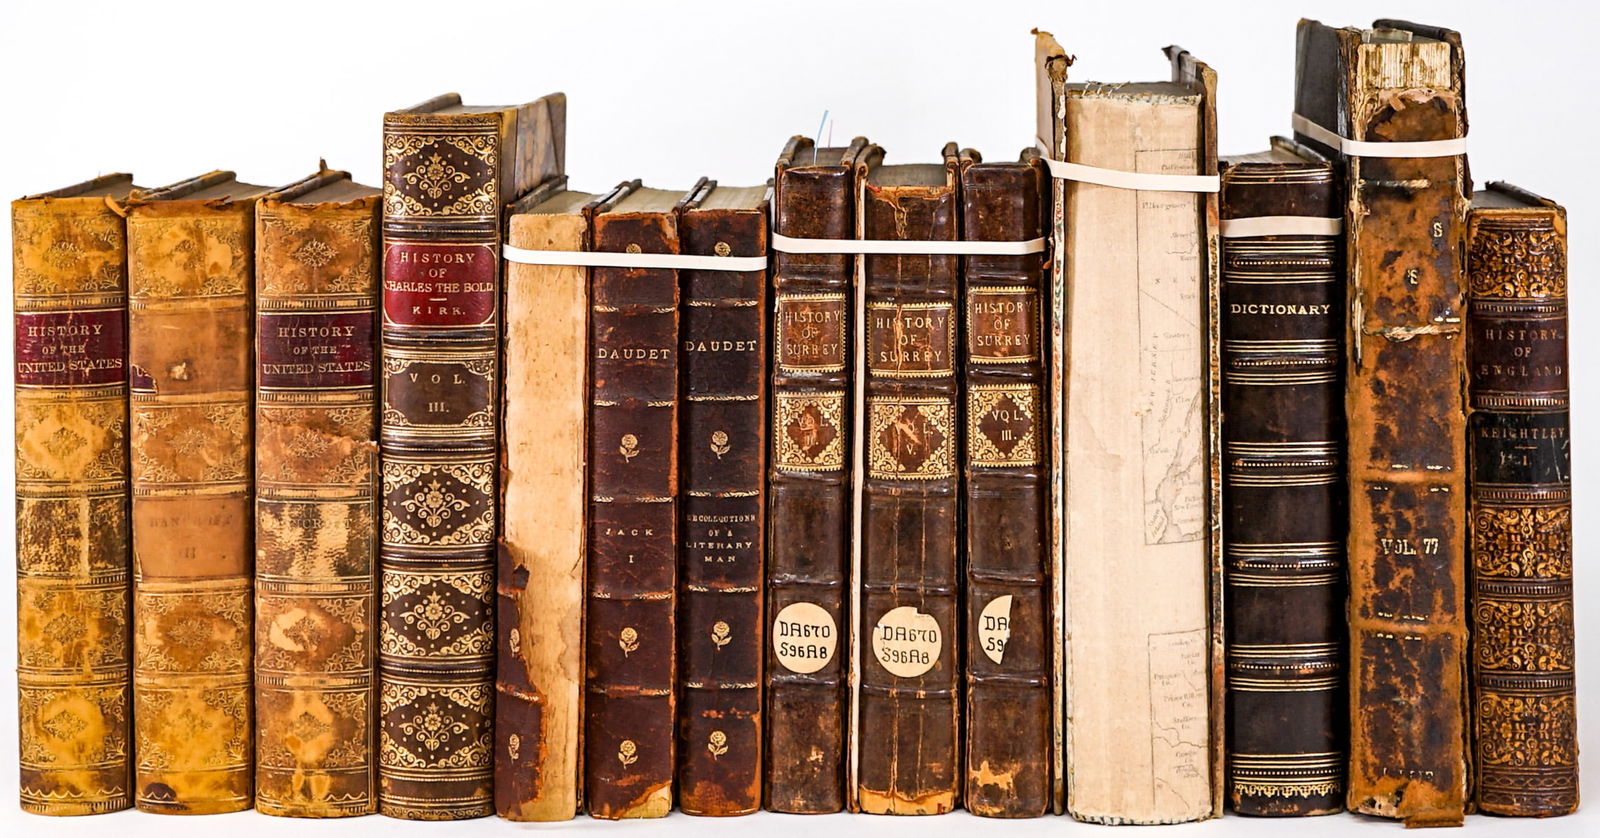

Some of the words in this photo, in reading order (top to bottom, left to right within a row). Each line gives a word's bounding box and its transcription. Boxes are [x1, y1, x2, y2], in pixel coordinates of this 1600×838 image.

[400, 252, 476, 264] HISTORY
[428, 268, 448, 278] OF
[384, 281, 432, 292] CHARLES
[435, 282, 460, 293] THE
[412, 306, 466, 315] KIRK.
[974, 302, 1032, 314] HISTORY
[1231, 304, 1330, 315] DICTIONARY
[785, 310, 840, 322] HISTORY
[994, 318, 1011, 330] OF
[28, 324, 102, 337] HISTORY
[278, 326, 355, 338] HISTORY
[802, 328, 818, 338] OF
[1486, 328, 1558, 340] HISTORY
[686, 340, 757, 352] DAUDET
[900, 334, 917, 346] OF
[977, 334, 1030, 346] SURREY
[42, 346, 56, 354] OF
[60, 345, 85, 354] THE
[294, 346, 308, 355] OF
[312, 346, 337, 354] THE
[598, 348, 670, 360] DAUDET
[787, 344, 838, 356] SURREY
[1514, 346, 1532, 358] OF
[880, 350, 942, 362] SURREY
[18, 362, 66, 374] UNITED
[69, 358, 122, 370] STATES
[262, 364, 314, 374] UNITED
[318, 360, 371, 372] STATES
[1481, 366, 1562, 376] ENGLAND
[410, 373, 466, 384] VOL.
[428, 402, 450, 412] III.
[1002, 430, 1017, 441] III.
[1482, 427, 1564, 440] KEIGHTLEY
[606, 528, 654, 536] JACK
[708, 529, 720, 537] OF
[1380, 538, 1416, 555] VOL.
[1423, 538, 1438, 554] 77
[780, 620, 830, 638] DA670
[882, 626, 937, 643] DA670
[780, 642, 828, 658] S96A8
[881, 647, 930, 664] S96A8
